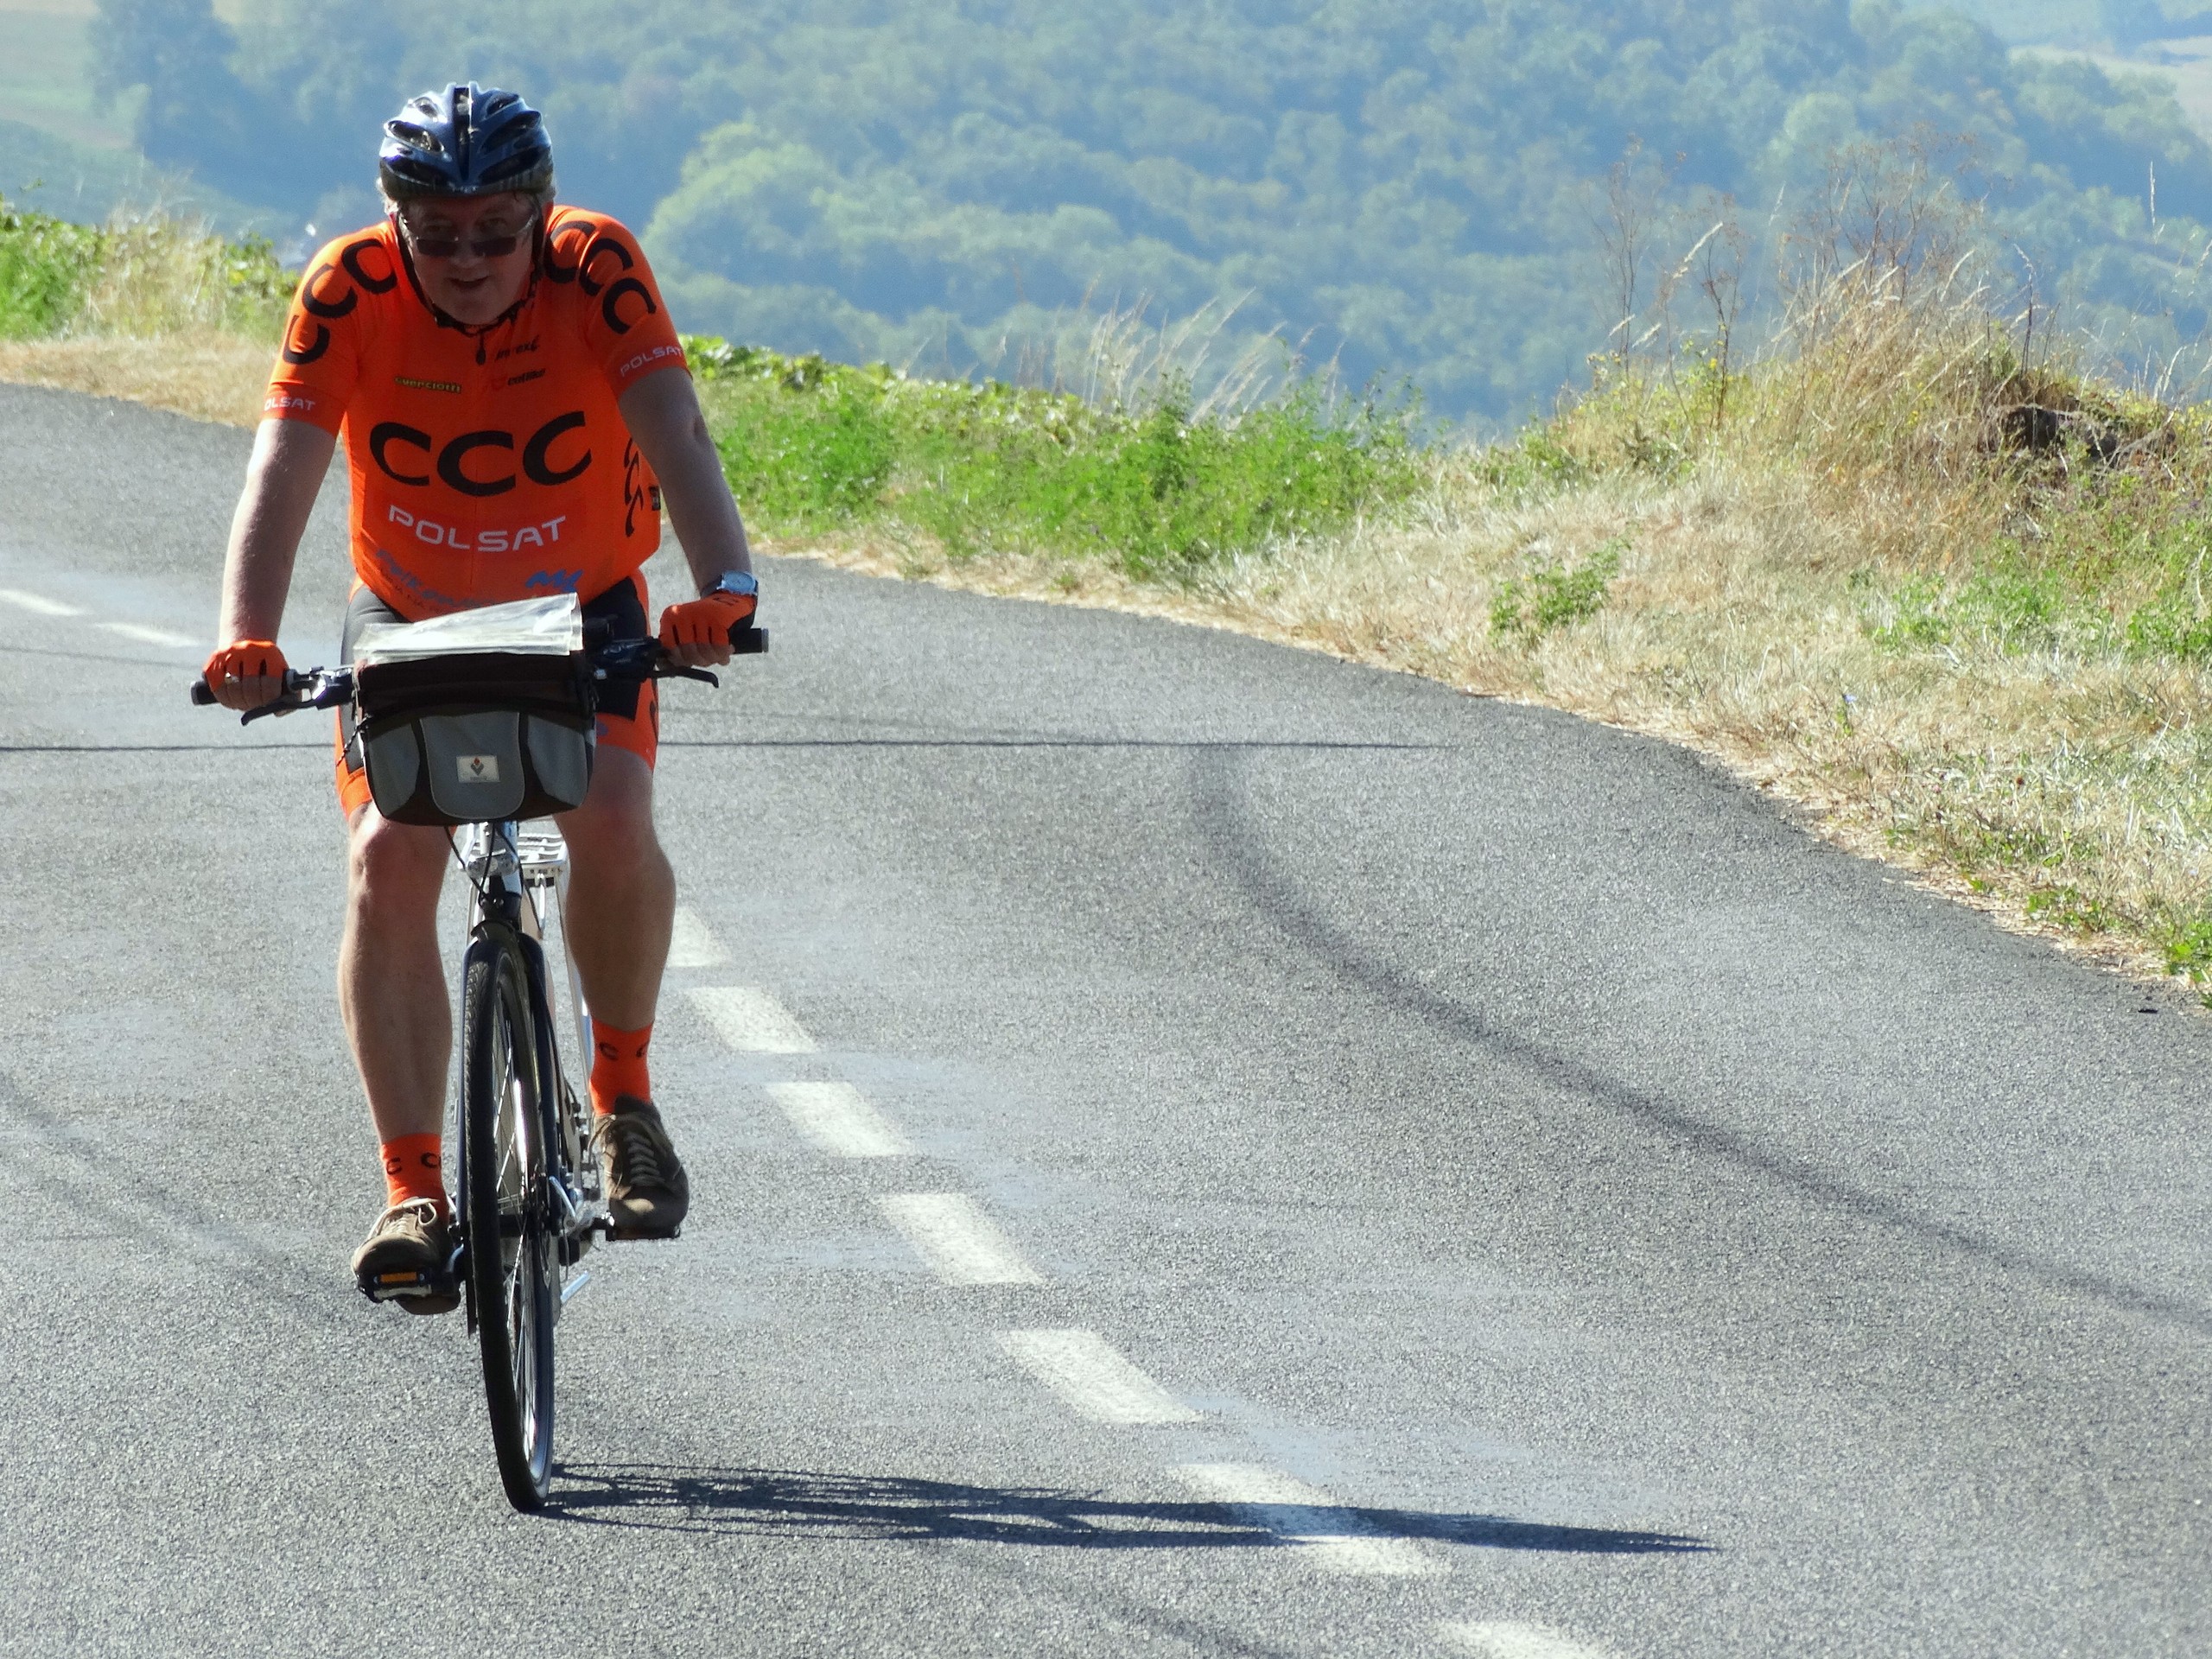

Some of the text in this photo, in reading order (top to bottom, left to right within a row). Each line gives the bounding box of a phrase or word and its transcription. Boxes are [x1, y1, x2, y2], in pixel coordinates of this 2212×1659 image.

[282, 238, 397, 365] CCC
[543, 220, 657, 335] CCC
[264, 396, 316, 411] OLSAT
[369, 410, 593, 497] CCC
[387, 505, 567, 552] POLSAT
